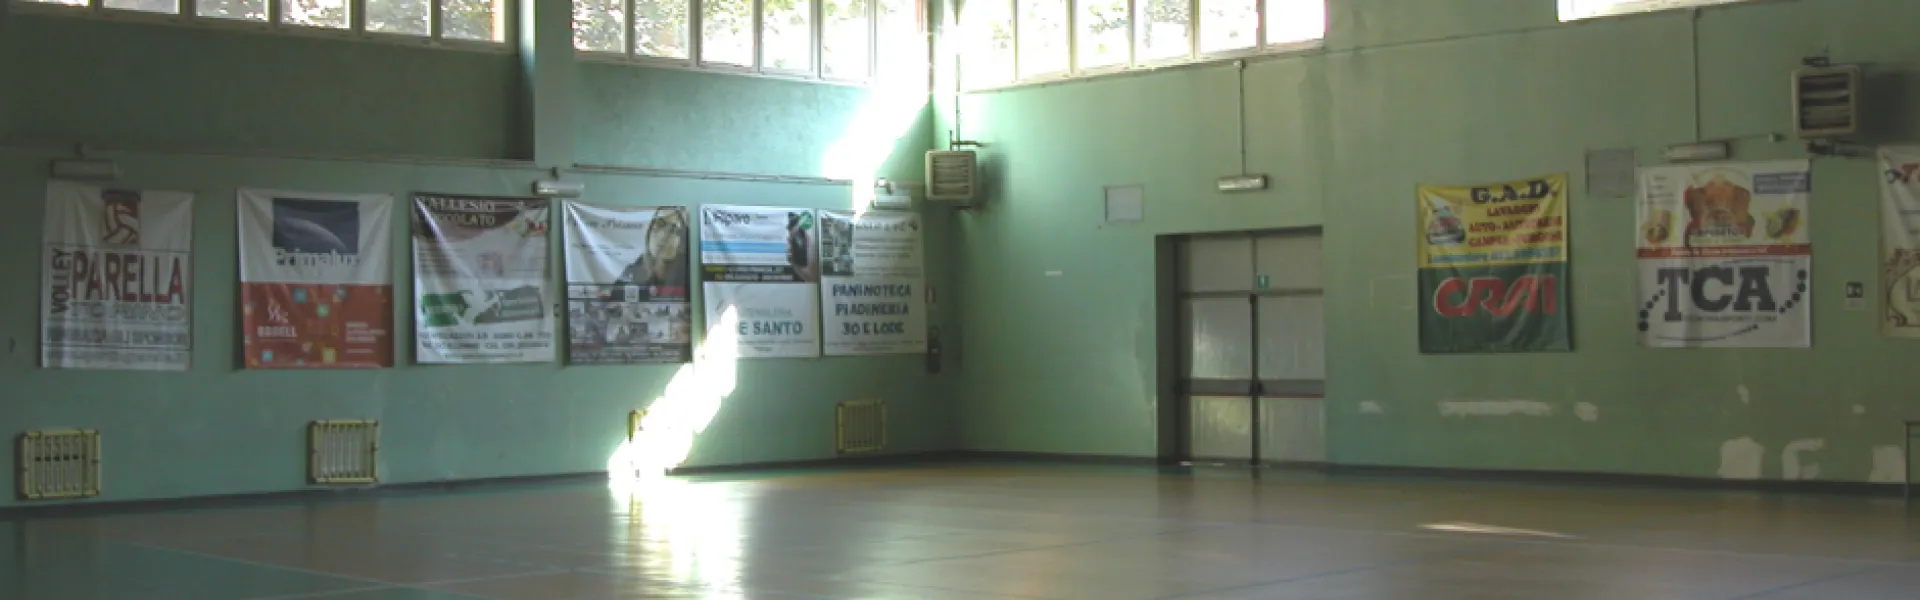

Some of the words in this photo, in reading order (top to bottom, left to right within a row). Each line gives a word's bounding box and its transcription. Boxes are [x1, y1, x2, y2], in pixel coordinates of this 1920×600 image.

[51, 249, 71, 315] VOLLEY
[73, 251, 185, 304] PARELLA
[832, 284, 912, 297] PANINOTECA
[1434, 275, 1557, 317] CRAI
[1658, 265, 1776, 321] TCA
[753, 321, 804, 337] SANTO
[842, 322, 860, 335] 30
[863, 323, 871, 335] E
